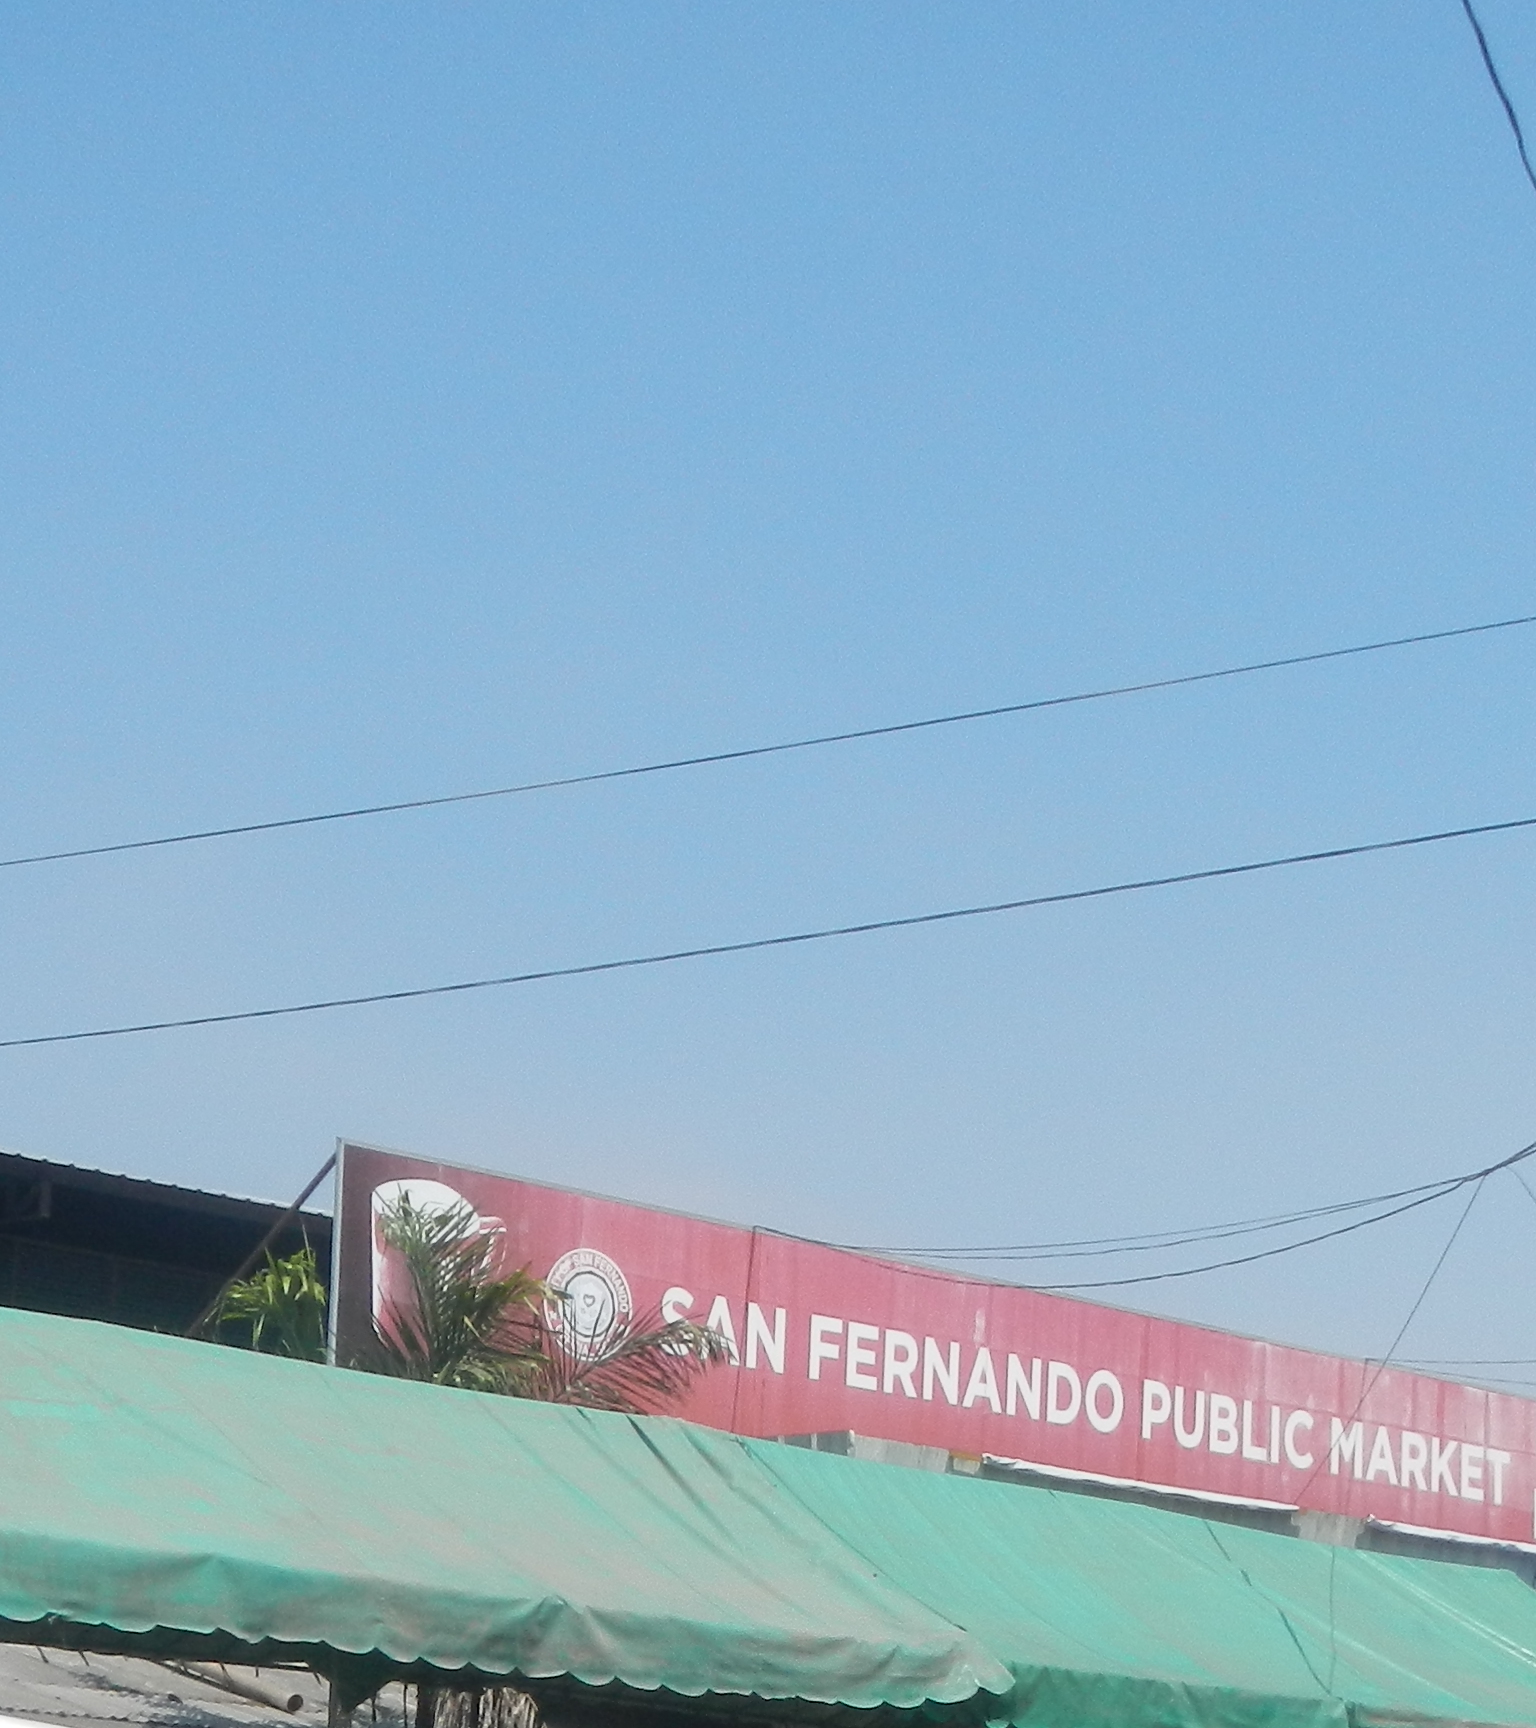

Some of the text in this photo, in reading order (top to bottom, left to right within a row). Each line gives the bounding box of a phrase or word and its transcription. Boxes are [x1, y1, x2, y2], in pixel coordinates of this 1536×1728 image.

[593, 1255, 630, 1313] FERNANDO
[659, 1287, 1512, 1506] SAN FERNANDO PUBLIC MARKET
